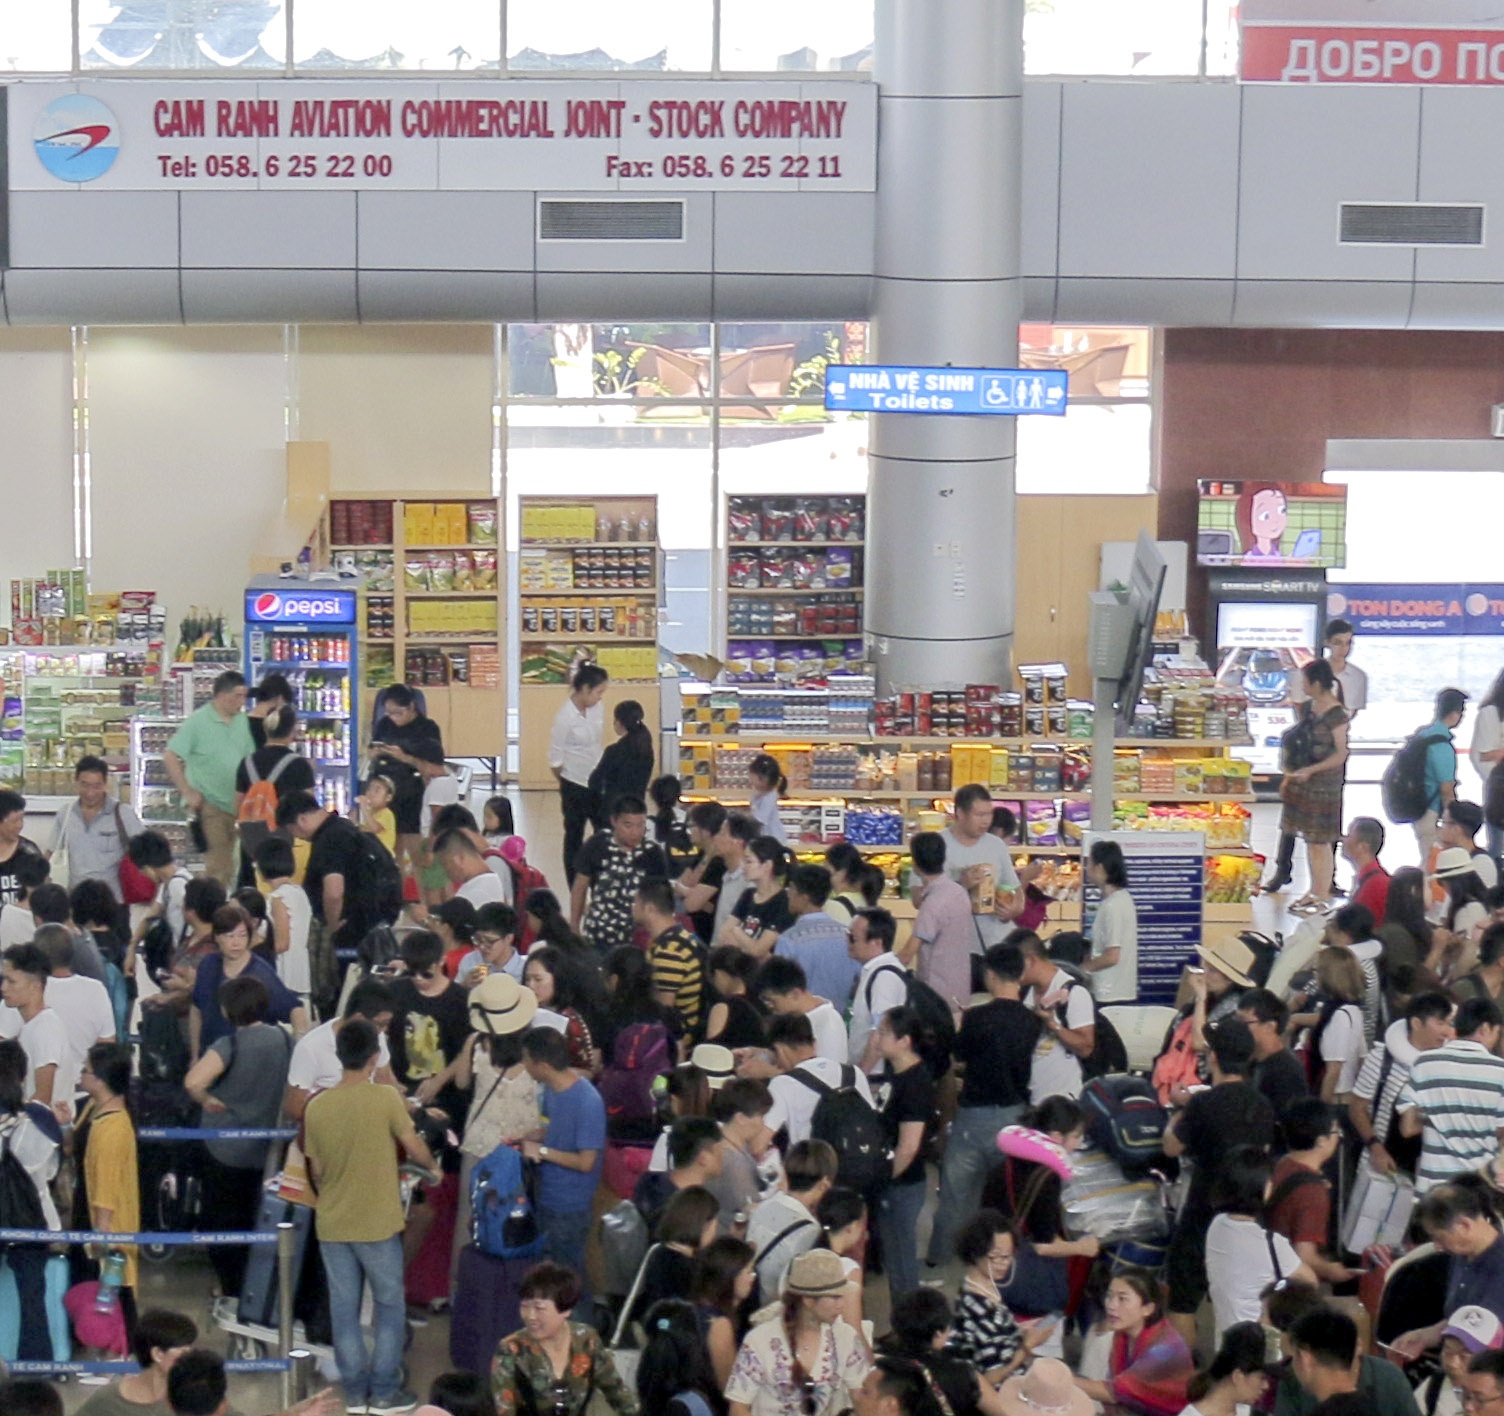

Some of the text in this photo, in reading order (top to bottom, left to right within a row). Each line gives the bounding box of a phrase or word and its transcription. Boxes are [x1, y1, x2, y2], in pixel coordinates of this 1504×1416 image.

[1281, 39, 1441, 83] ДОБРО
[154, 100, 205, 138] CAM
[217, 100, 279, 138] RANH
[291, 100, 392, 138] AVIATION
[401, 100, 554, 138] COMMERCIAL
[564, 100, 626, 139] JOINT
[648, 101, 725, 139] STOCK
[734, 101, 847, 139] COMPANY
[158, 155, 393, 178] Tel: 058. 6 25 22 00
[606, 156, 842, 178] Fax: 058. 6 25 22 11
[849, 370, 891, 389] NHÀ
[924, 374, 975, 392] SINH
[868, 392, 954, 410] Toilets
[284, 597, 341, 618] pepsi
